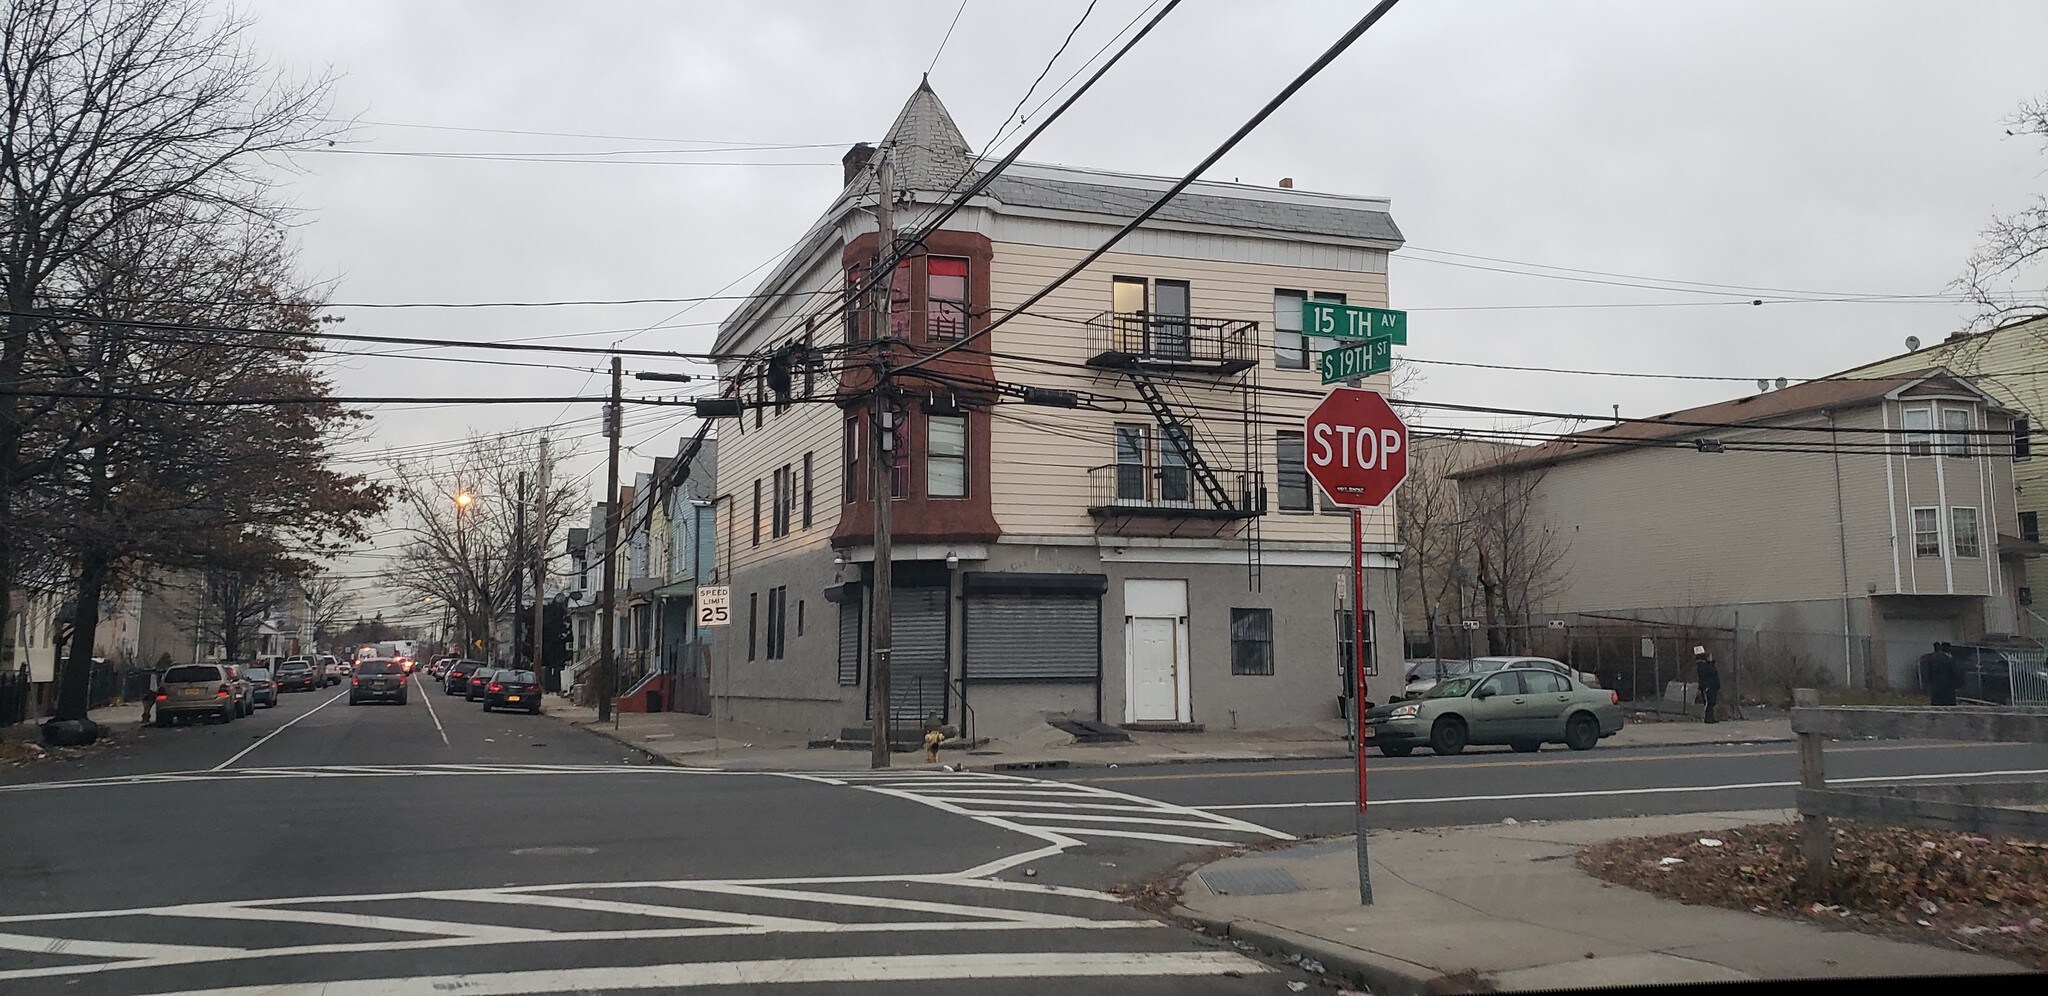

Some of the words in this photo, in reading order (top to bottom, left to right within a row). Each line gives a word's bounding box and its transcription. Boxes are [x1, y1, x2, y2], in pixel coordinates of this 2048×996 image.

[1313, 307, 1335, 333] 15
[1346, 310, 1372, 337] TH
[1381, 314, 1396, 328] AV
[1325, 354, 1334, 379] S
[1340, 344, 1373, 376] 19TH
[1377, 341, 1388, 356] ST
[1312, 423, 1401, 471] STOP
[702, 607, 728, 622] 25
